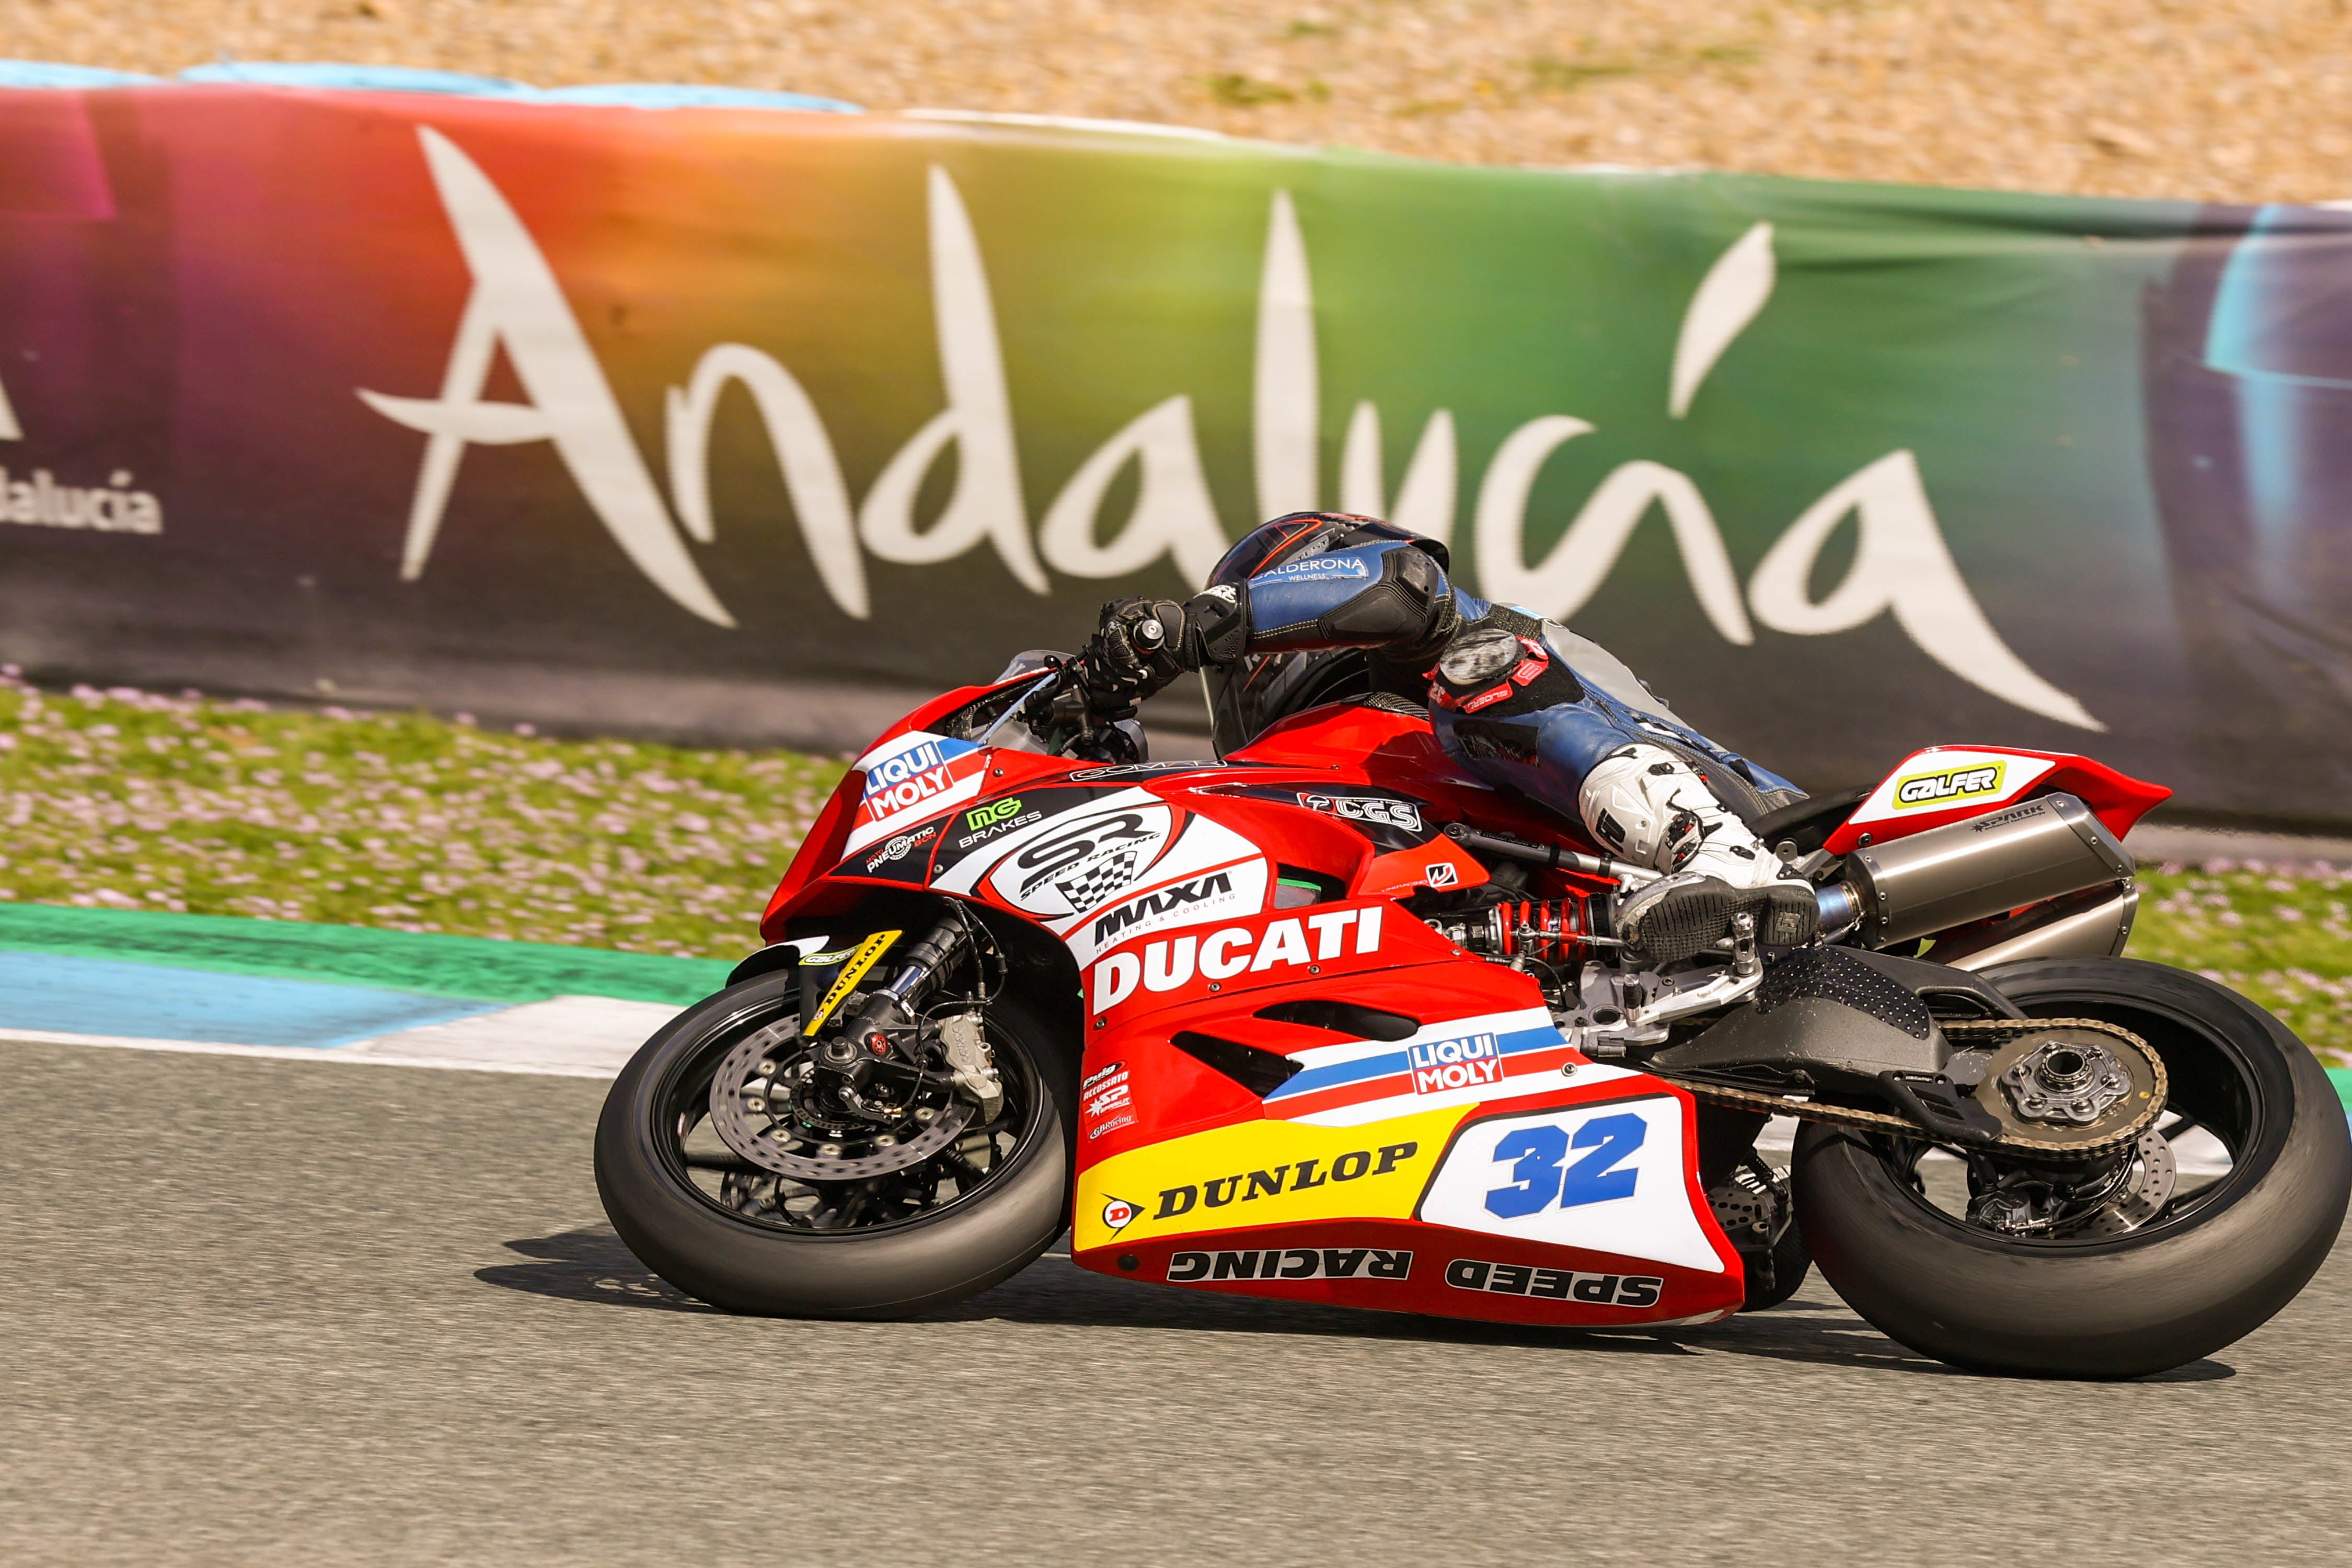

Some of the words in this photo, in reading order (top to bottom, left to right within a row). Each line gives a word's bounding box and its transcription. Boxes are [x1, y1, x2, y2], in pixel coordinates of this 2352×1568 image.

[357, 124, 2105, 731] Andalucía
[1288, 573, 1326, 582] WELLNESS
[866, 743, 938, 795] LIQUI
[871, 766, 945, 818] MOLY
[1900, 767, 1997, 803] GALFER
[959, 811, 1042, 848] BRAKES
[1336, 800, 1418, 829] CGS
[1979, 804, 2044, 827] SPARK
[867, 826, 935, 873] PNEUMATIC
[1020, 862, 1079, 901] SPEED
[1087, 832, 1162, 862] RACING
[1094, 872, 1233, 947] MAXA
[1096, 921, 1151, 954] HEATING
[1173, 894, 1236, 917] COOLING
[825, 934, 885, 1006] DUNLOP
[1093, 906, 1382, 1016] DUCATI
[1413, 1035, 1493, 1068] LIQUI
[1082, 1064, 1116, 1090] Puig
[1083, 1071, 1129, 1101] ACCOSSATO
[1417, 1059, 1497, 1093] MOLY
[1153, 1142, 1418, 1220] DUNLOP
[1484, 1113, 1647, 1219] 32
[1167, 1249, 1413, 1281] RACING
[1446, 1259, 1663, 1307] SPEED
